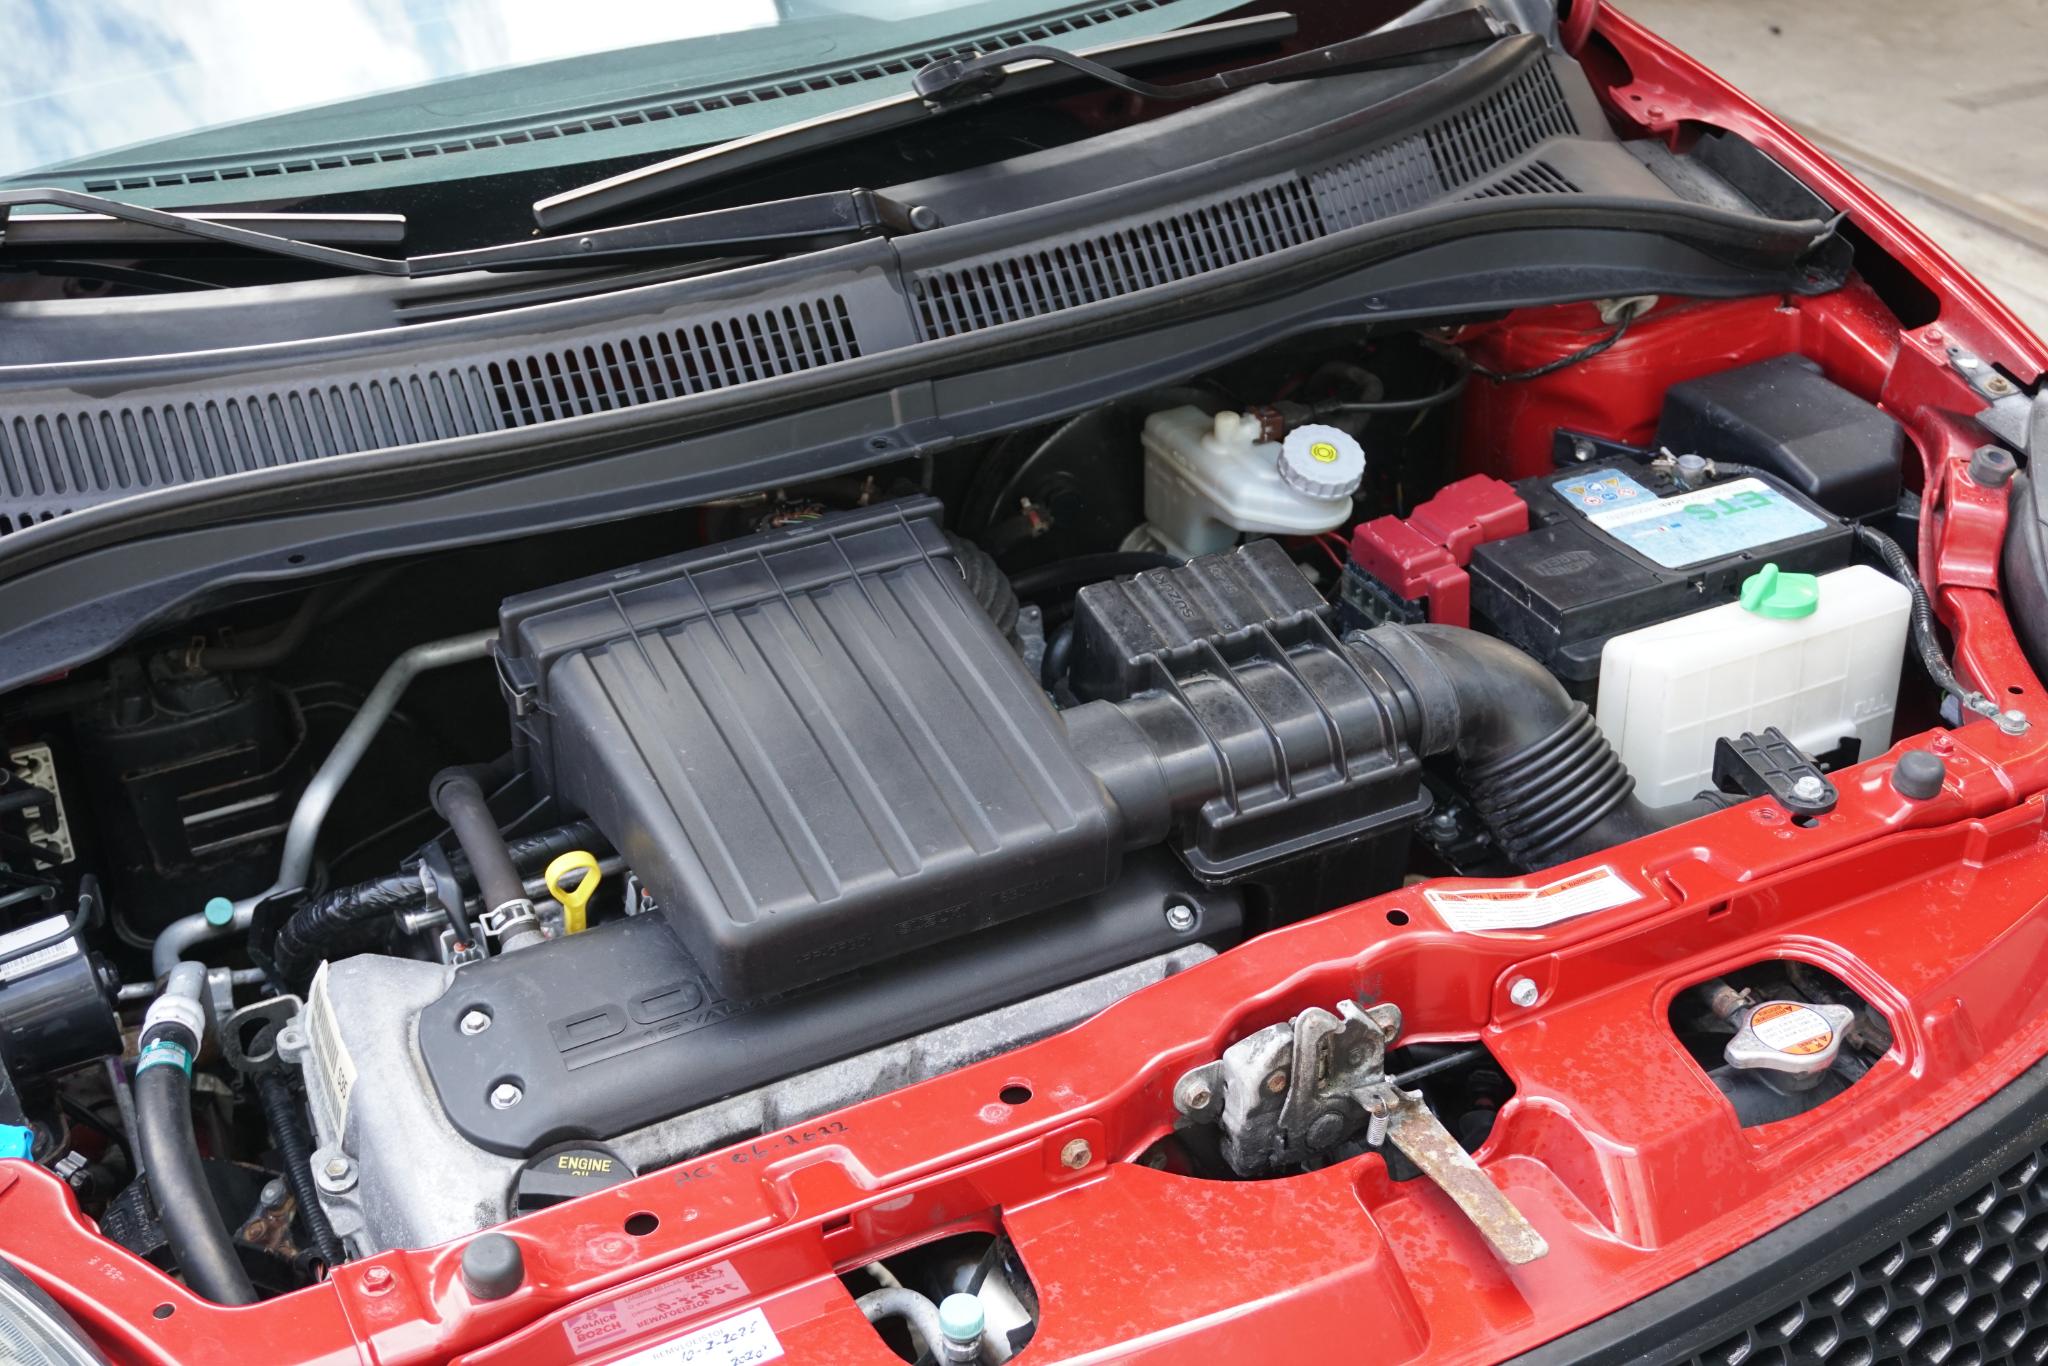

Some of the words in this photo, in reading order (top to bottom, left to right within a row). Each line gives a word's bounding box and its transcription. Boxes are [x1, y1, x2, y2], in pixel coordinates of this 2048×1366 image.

[1150, 570, 1196, 619] SUZUKI
[1852, 692, 1890, 719] FULL
[558, 1156, 612, 1173] ENGINE
